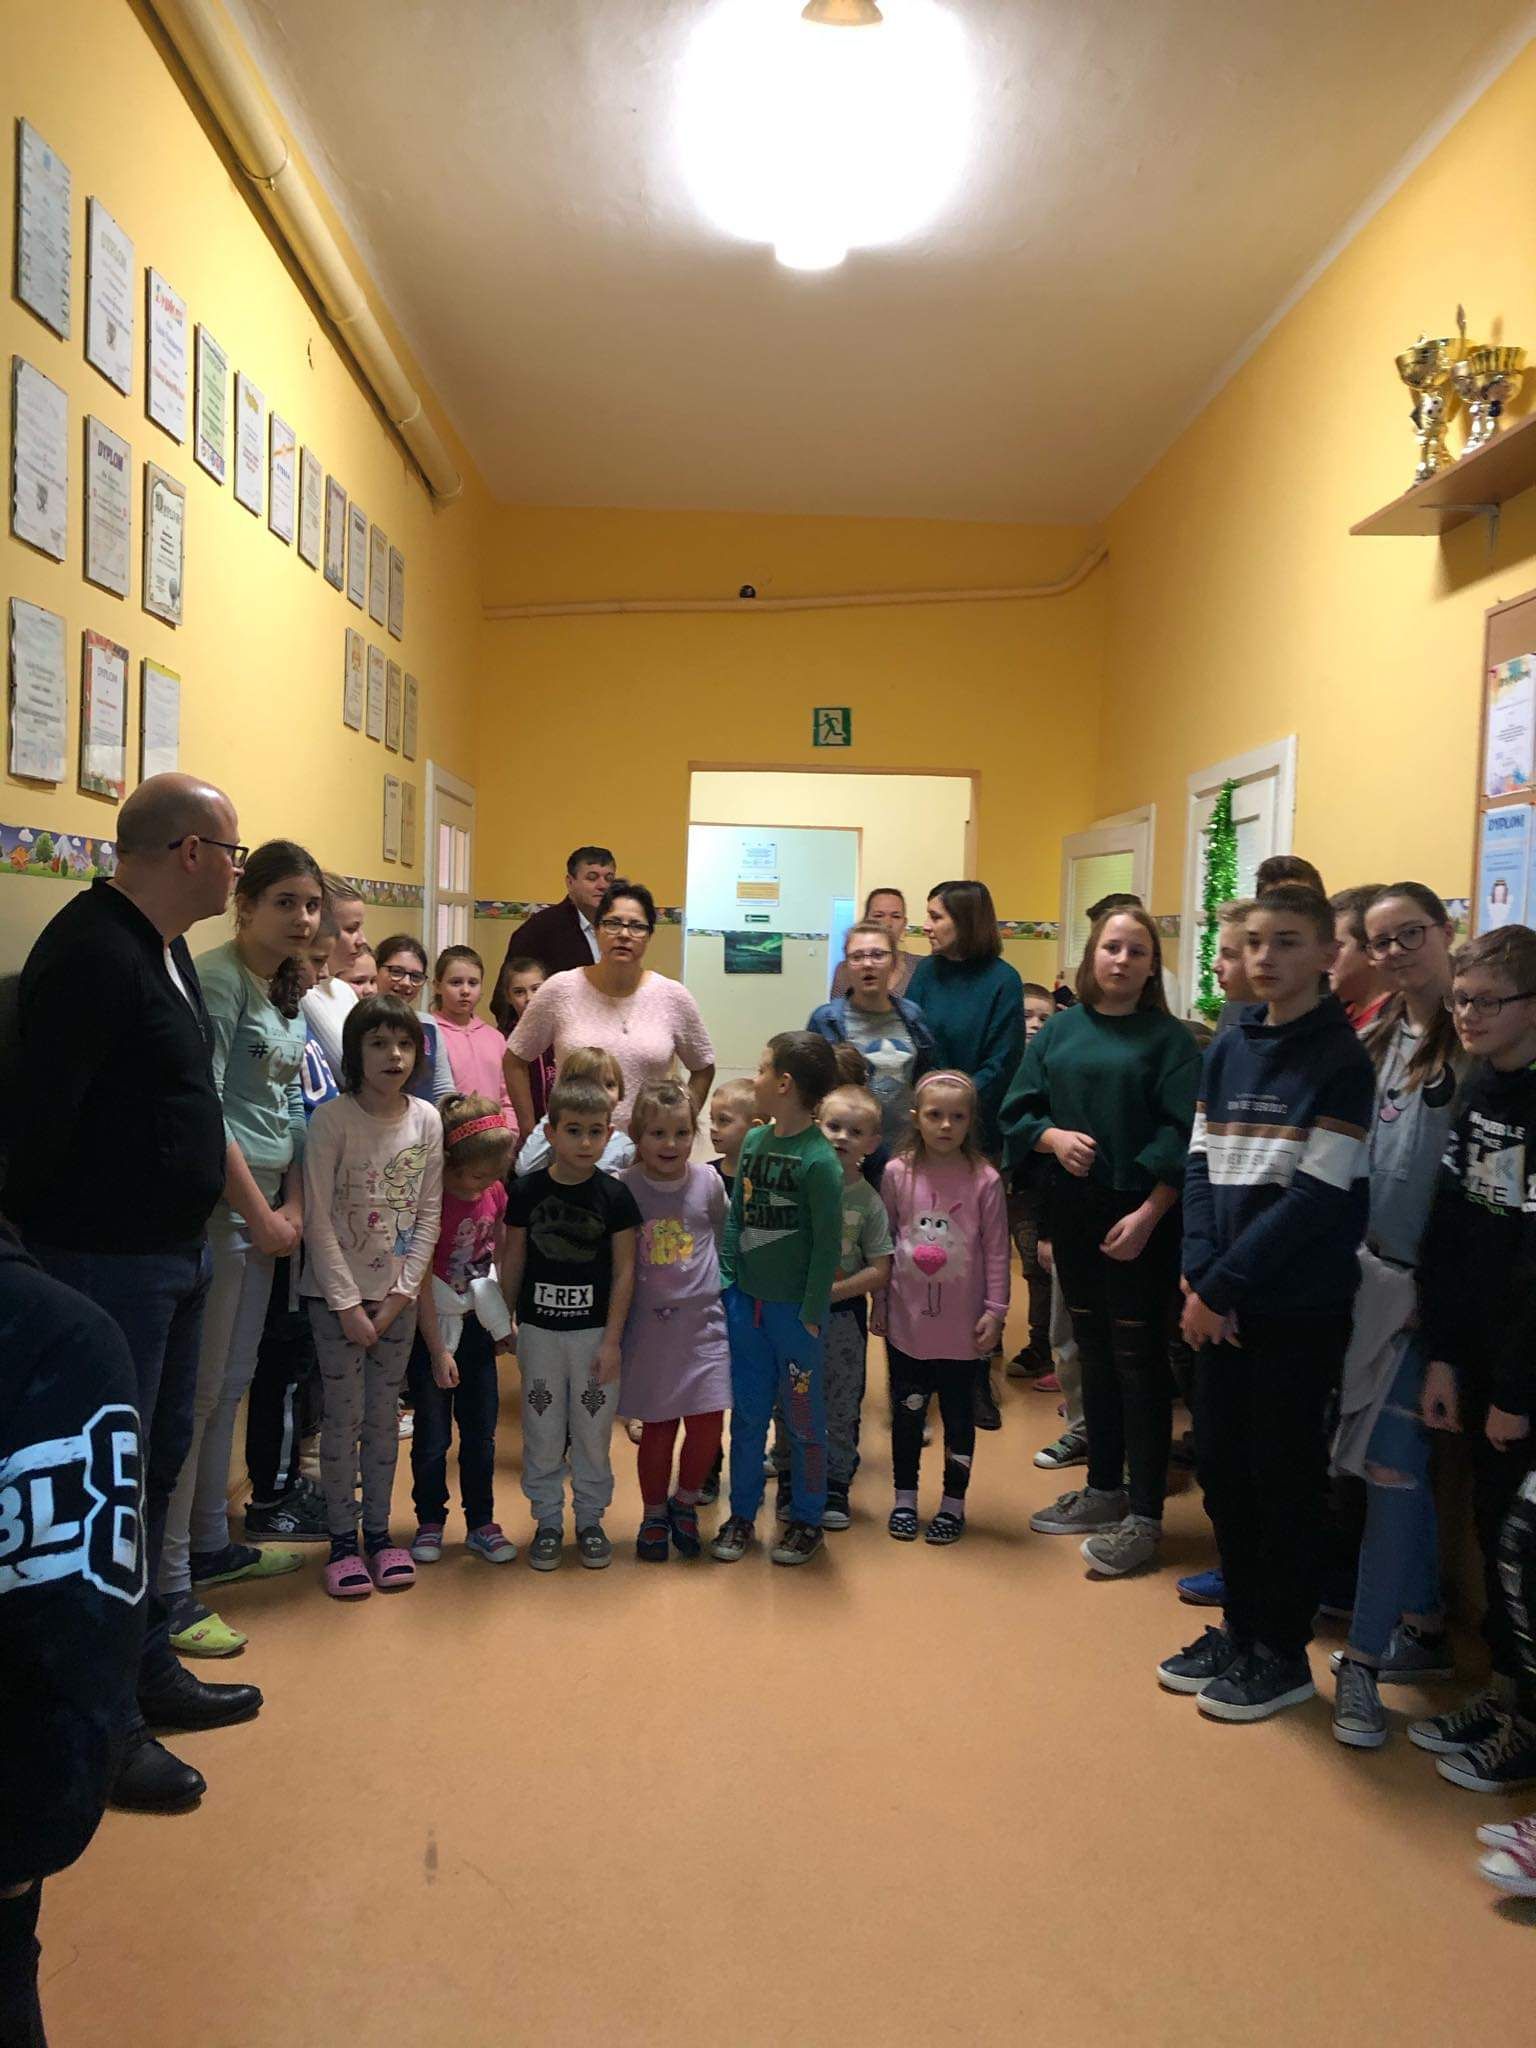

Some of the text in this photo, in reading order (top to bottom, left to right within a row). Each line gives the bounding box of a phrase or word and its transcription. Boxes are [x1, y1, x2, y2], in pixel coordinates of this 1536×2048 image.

[98, 439, 123, 472] DYPLOM
[97, 666, 118, 684] DYPLOM
[1488, 814, 1525, 831] DYPLOM
[539, 1285, 589, 1307] T-REX
